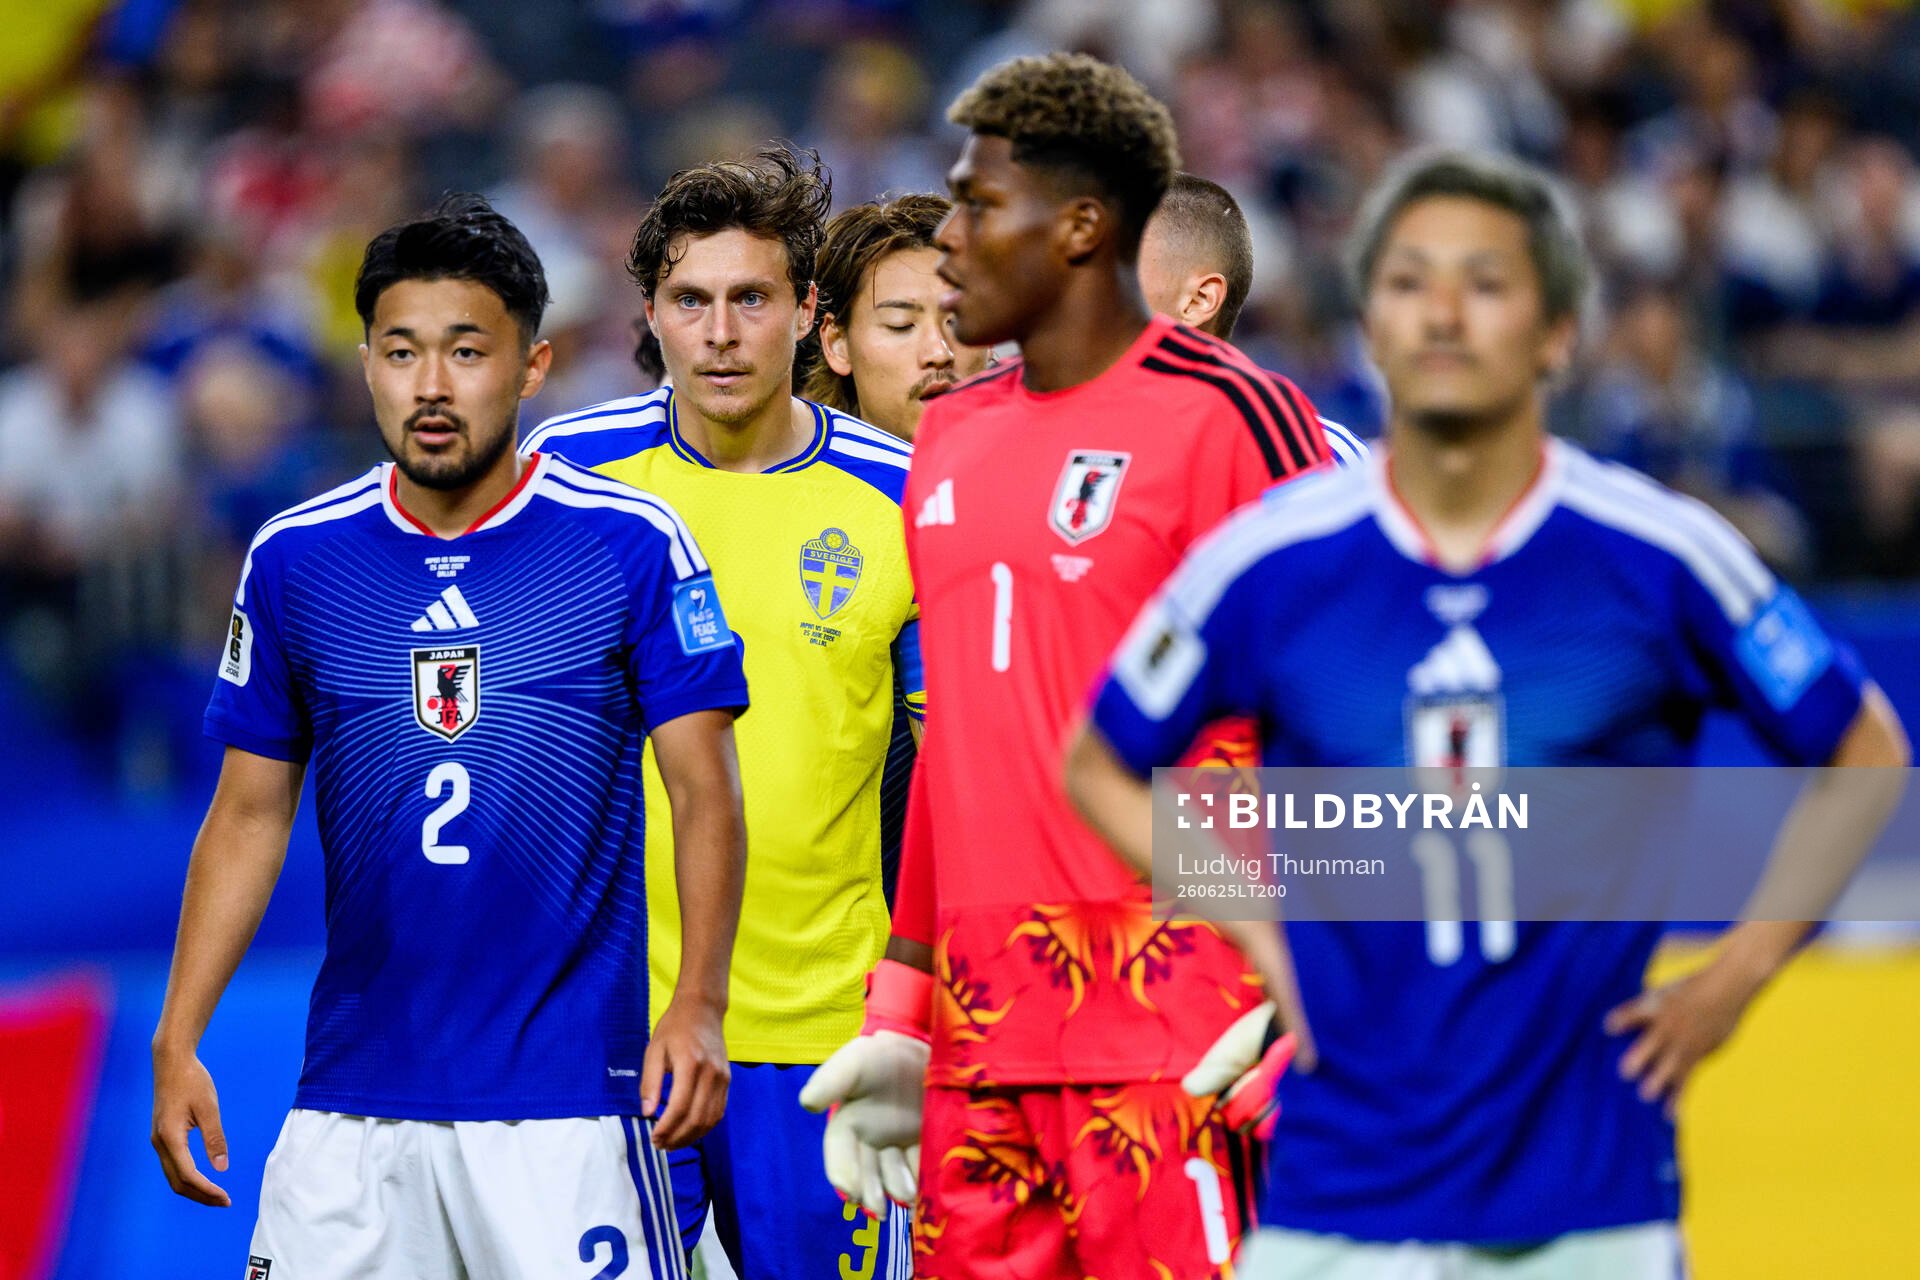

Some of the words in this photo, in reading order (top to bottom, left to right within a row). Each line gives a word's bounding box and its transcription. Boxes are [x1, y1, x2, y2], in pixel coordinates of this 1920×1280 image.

[809, 550, 854, 565] SVERIGE
[991, 561, 1014, 673] 1
[691, 620, 719, 638] PEACE
[800, 622, 814, 630] JAPAN
[822, 626, 842, 637] SWEDEN
[809, 638, 827, 647] DALLAS
[429, 649, 465, 660] JAPAN
[435, 709, 464, 725] JFA
[421, 762, 470, 865] 2
[1410, 829, 1517, 967] 11
[1184, 1157, 1231, 1265] 1
[838, 1202, 881, 1280] 3
